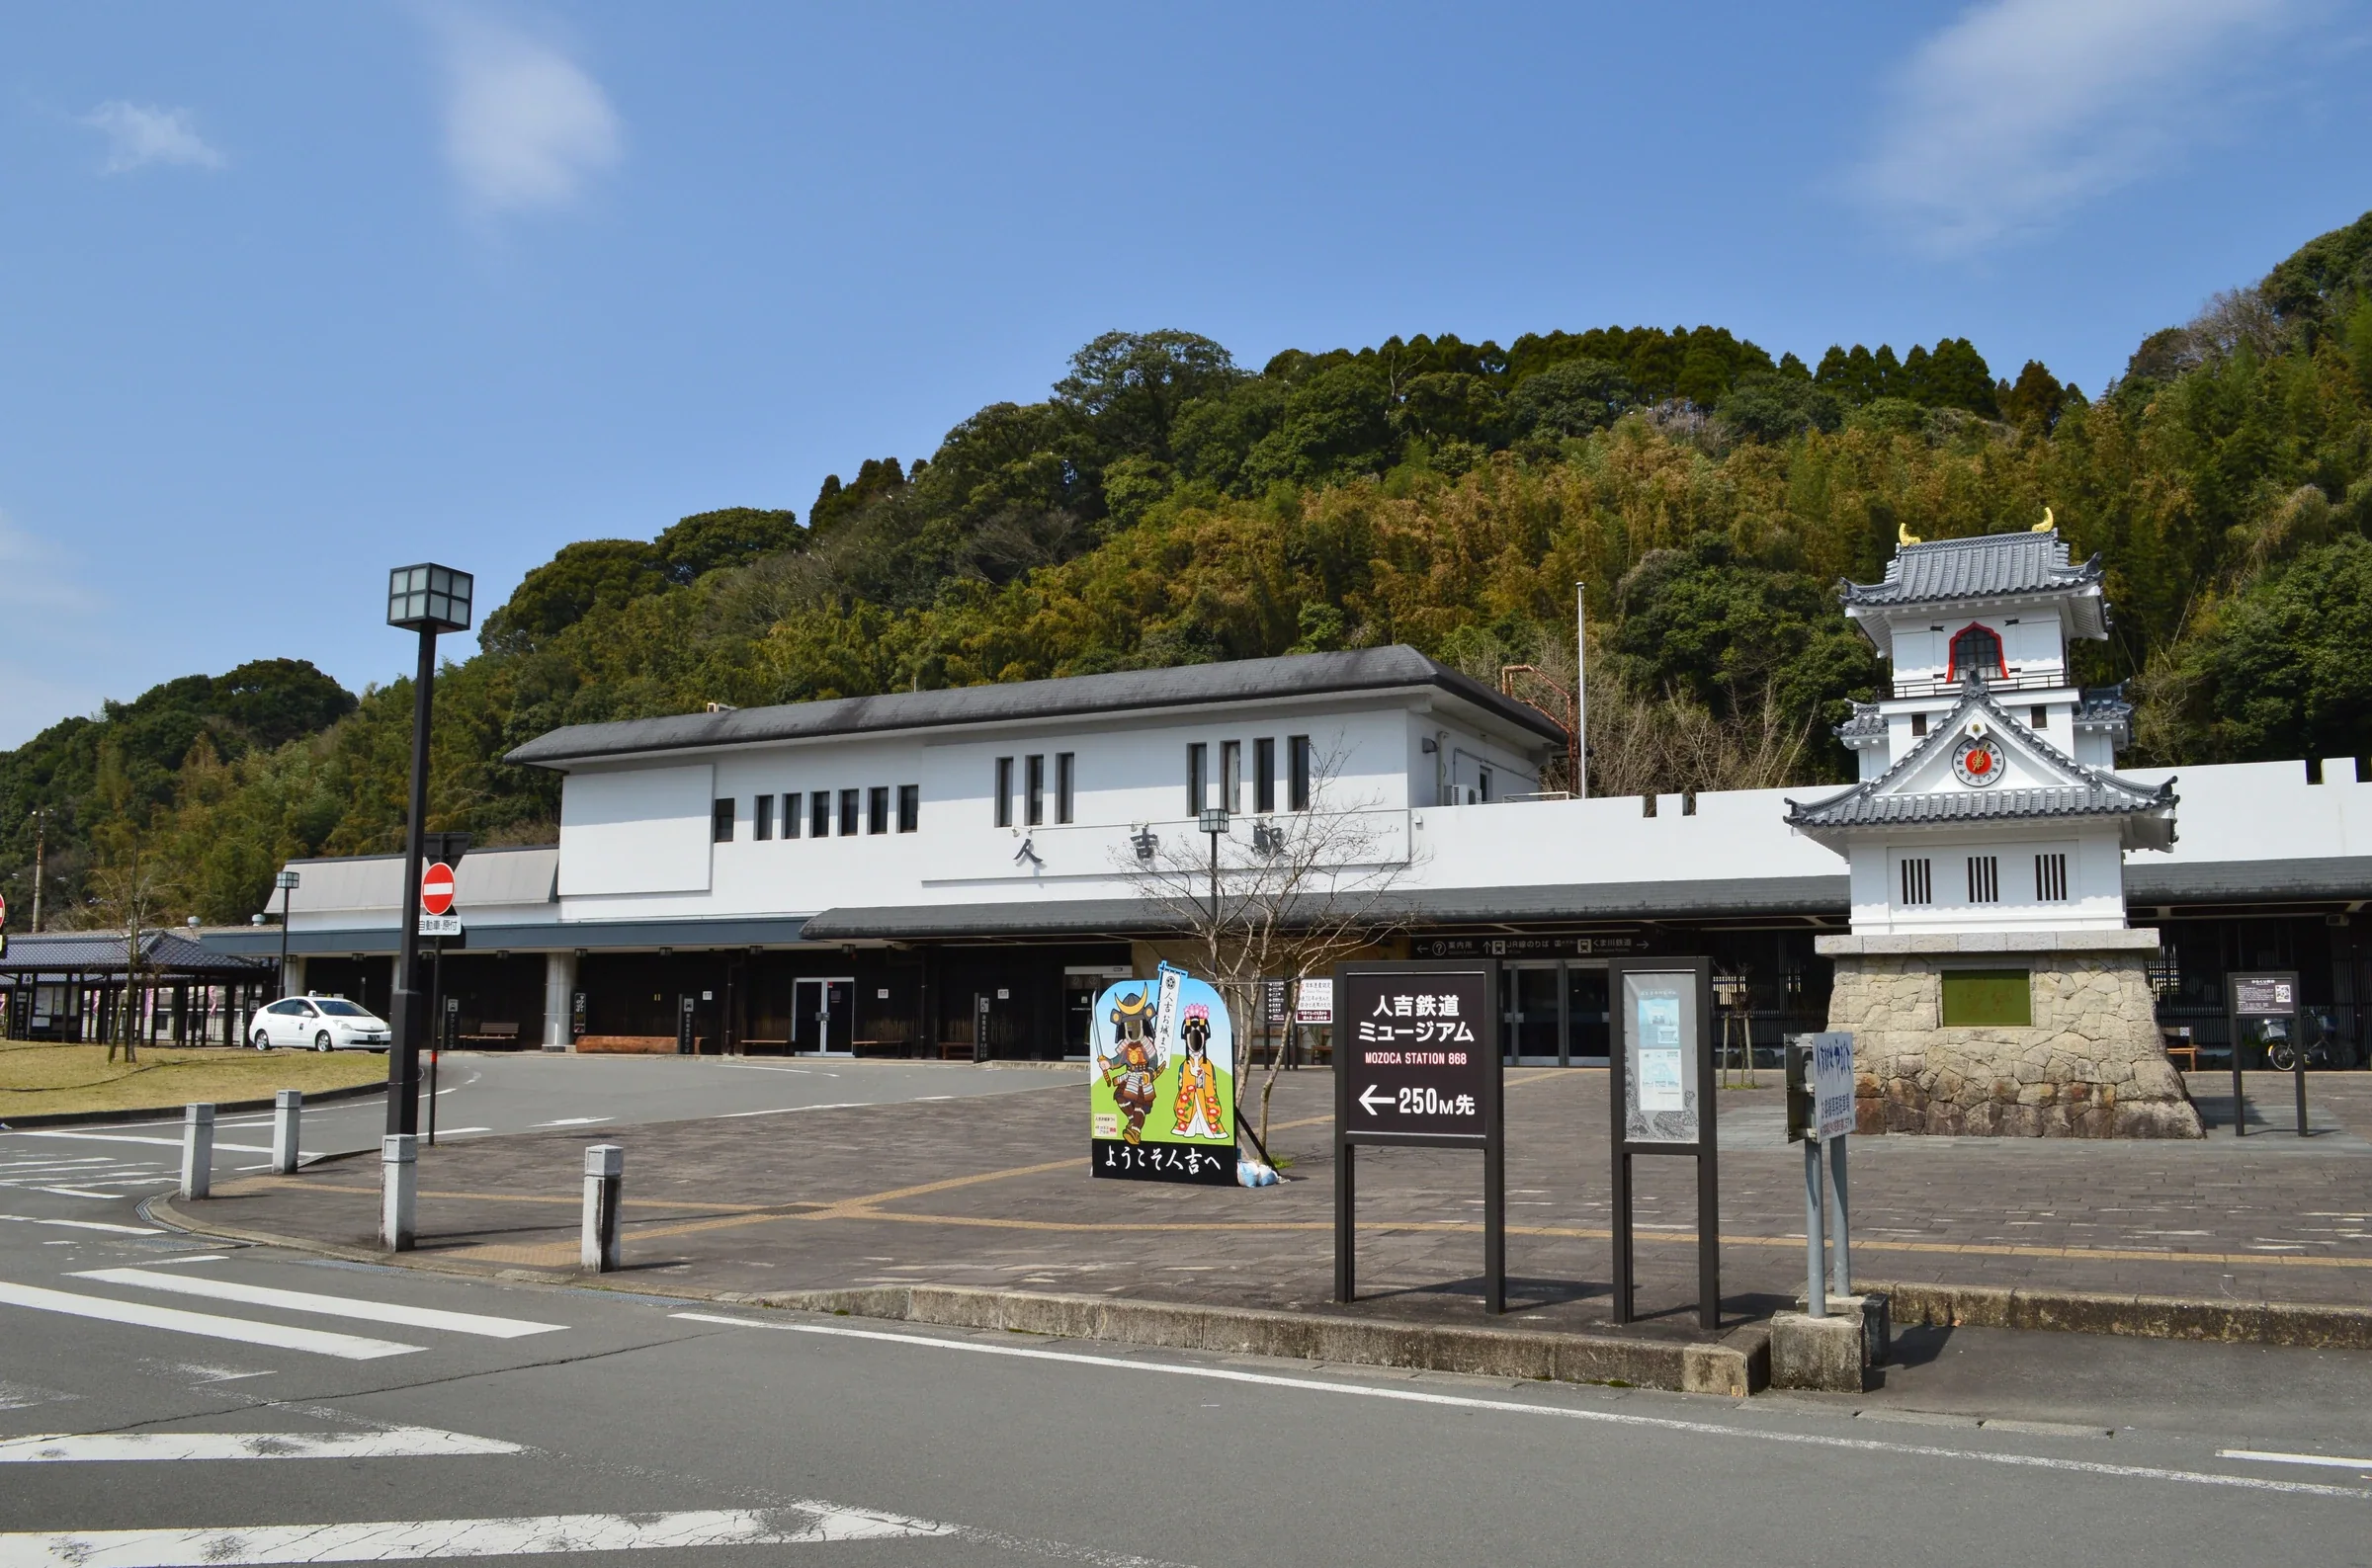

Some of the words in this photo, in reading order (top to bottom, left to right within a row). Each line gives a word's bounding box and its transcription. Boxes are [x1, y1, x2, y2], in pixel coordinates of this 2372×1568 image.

[1373, 995, 1459, 1017] 人吉鉄道
[1359, 1021, 1475, 1042] ミュージアム
[1365, 1052, 1401, 1064] MOZOCA
[1404, 1052, 1445, 1064] STATION
[1448, 1052, 1467, 1064] 868
[1398, 1087, 1476, 1115] 250M先
[1105, 1144, 1222, 1175] ようこそ人吉へ
